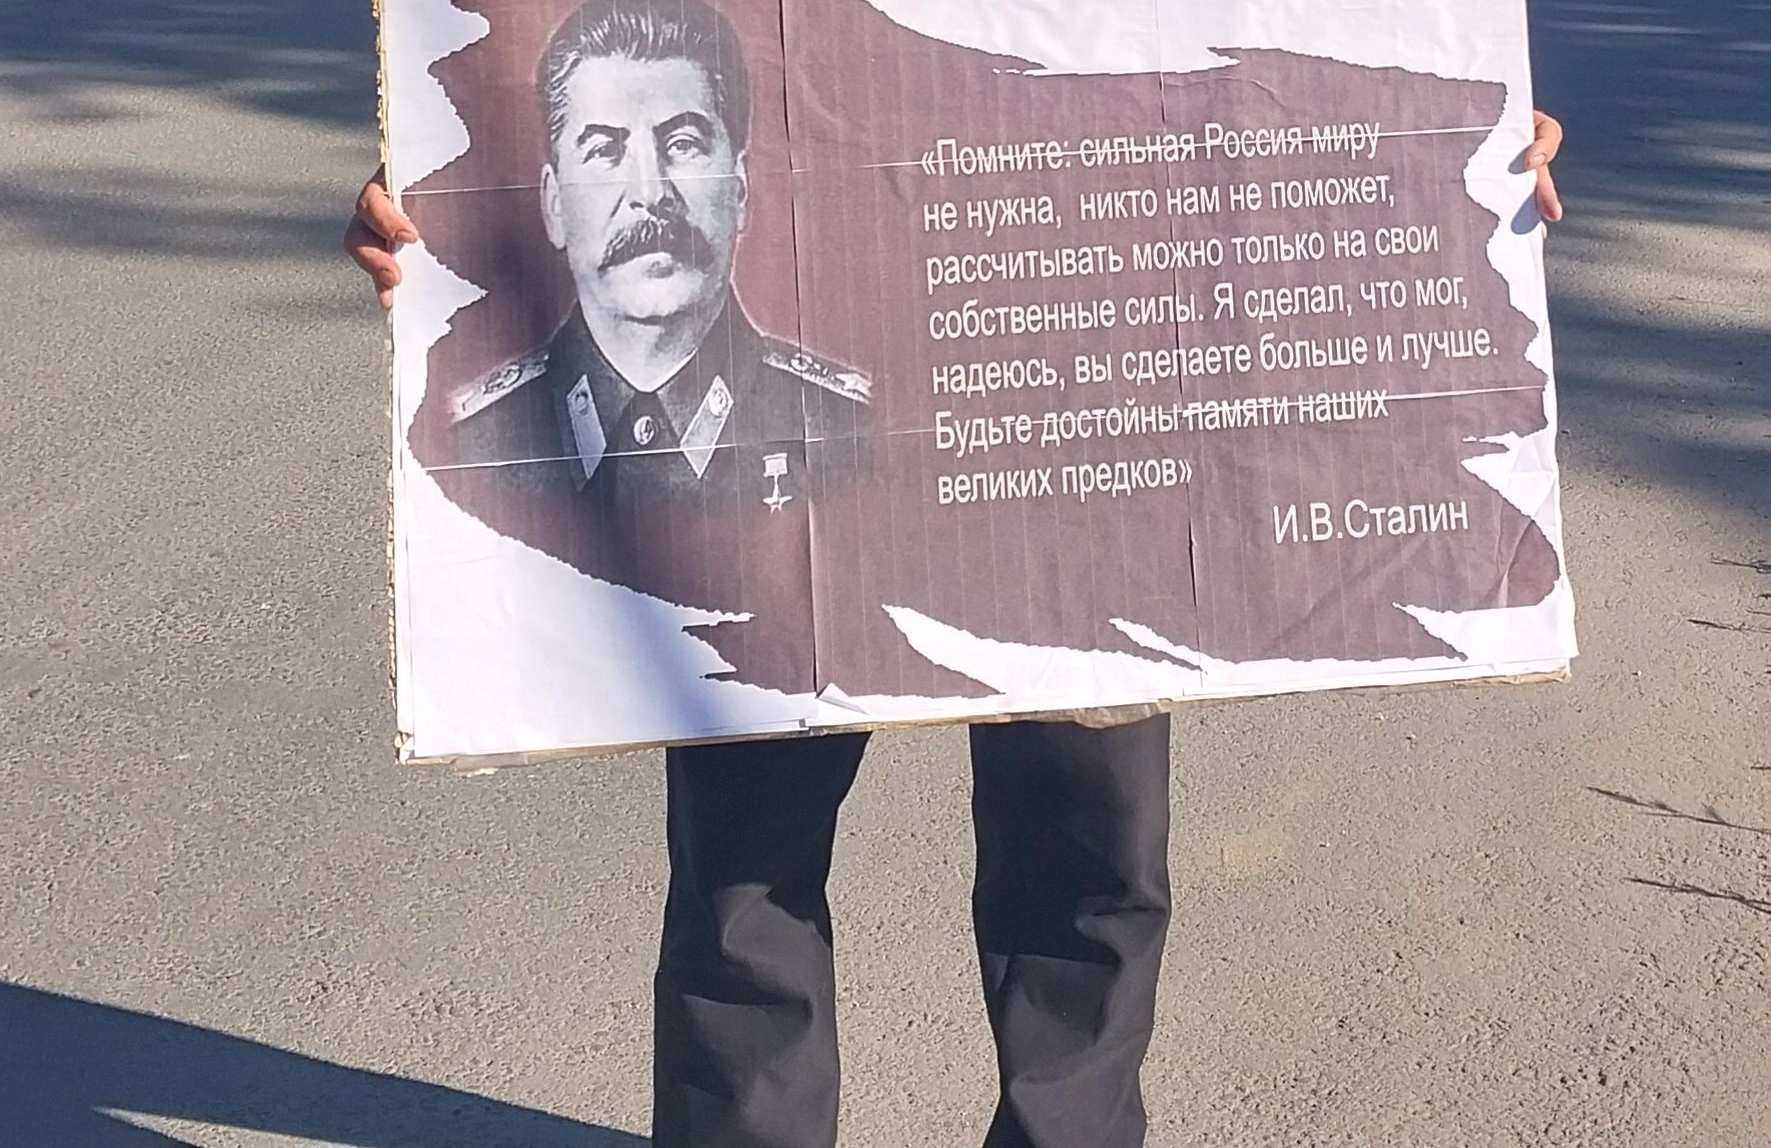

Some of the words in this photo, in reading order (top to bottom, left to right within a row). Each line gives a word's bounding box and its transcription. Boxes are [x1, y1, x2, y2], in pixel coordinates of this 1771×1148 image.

[921, 138, 1071, 176] «Помните:
[1080, 133, 1196, 167] сильная
[1204, 122, 1303, 160] Россия
[1312, 122, 1380, 160] миру
[923, 202, 958, 232] не
[966, 195, 1062, 237] нужна,
[1080, 188, 1158, 221] никто
[1166, 185, 1220, 216] нам
[1229, 182, 1262, 212] не
[1271, 174, 1395, 209] поможет,
[926, 245, 1124, 295] рассчитывать
[1132, 238, 1224, 271] можно
[1231, 231, 1325, 266] только
[1333, 228, 1367, 259] на
[1374, 224, 1439, 256] свои
[929, 299, 1116, 340] собственные
[1125, 294, 1204, 326] силы.
[1213, 282, 1235, 321] Я
[1243, 283, 1352, 323] сделал,
[1360, 280, 1407, 309] что
[1414, 276, 1468, 310] мог,
[932, 357, 1066, 399] надеюсь,
[1074, 353, 1113, 384] вы
[1121, 343, 1252, 386] сделаете
[1259, 332, 1368, 371] больше
[1376, 334, 1393, 363] и
[1401, 327, 1499, 369] лучше.
[935, 410, 1032, 458] Будьте
[1040, 397, 1178, 448] достойны
[1185, 396, 1289, 431] памяти
[1298, 389, 1389, 423] наших
[937, 467, 1054, 505] великих
[1062, 457, 1193, 502] предков»
[1273, 499, 1469, 544] И.В.Сталин
